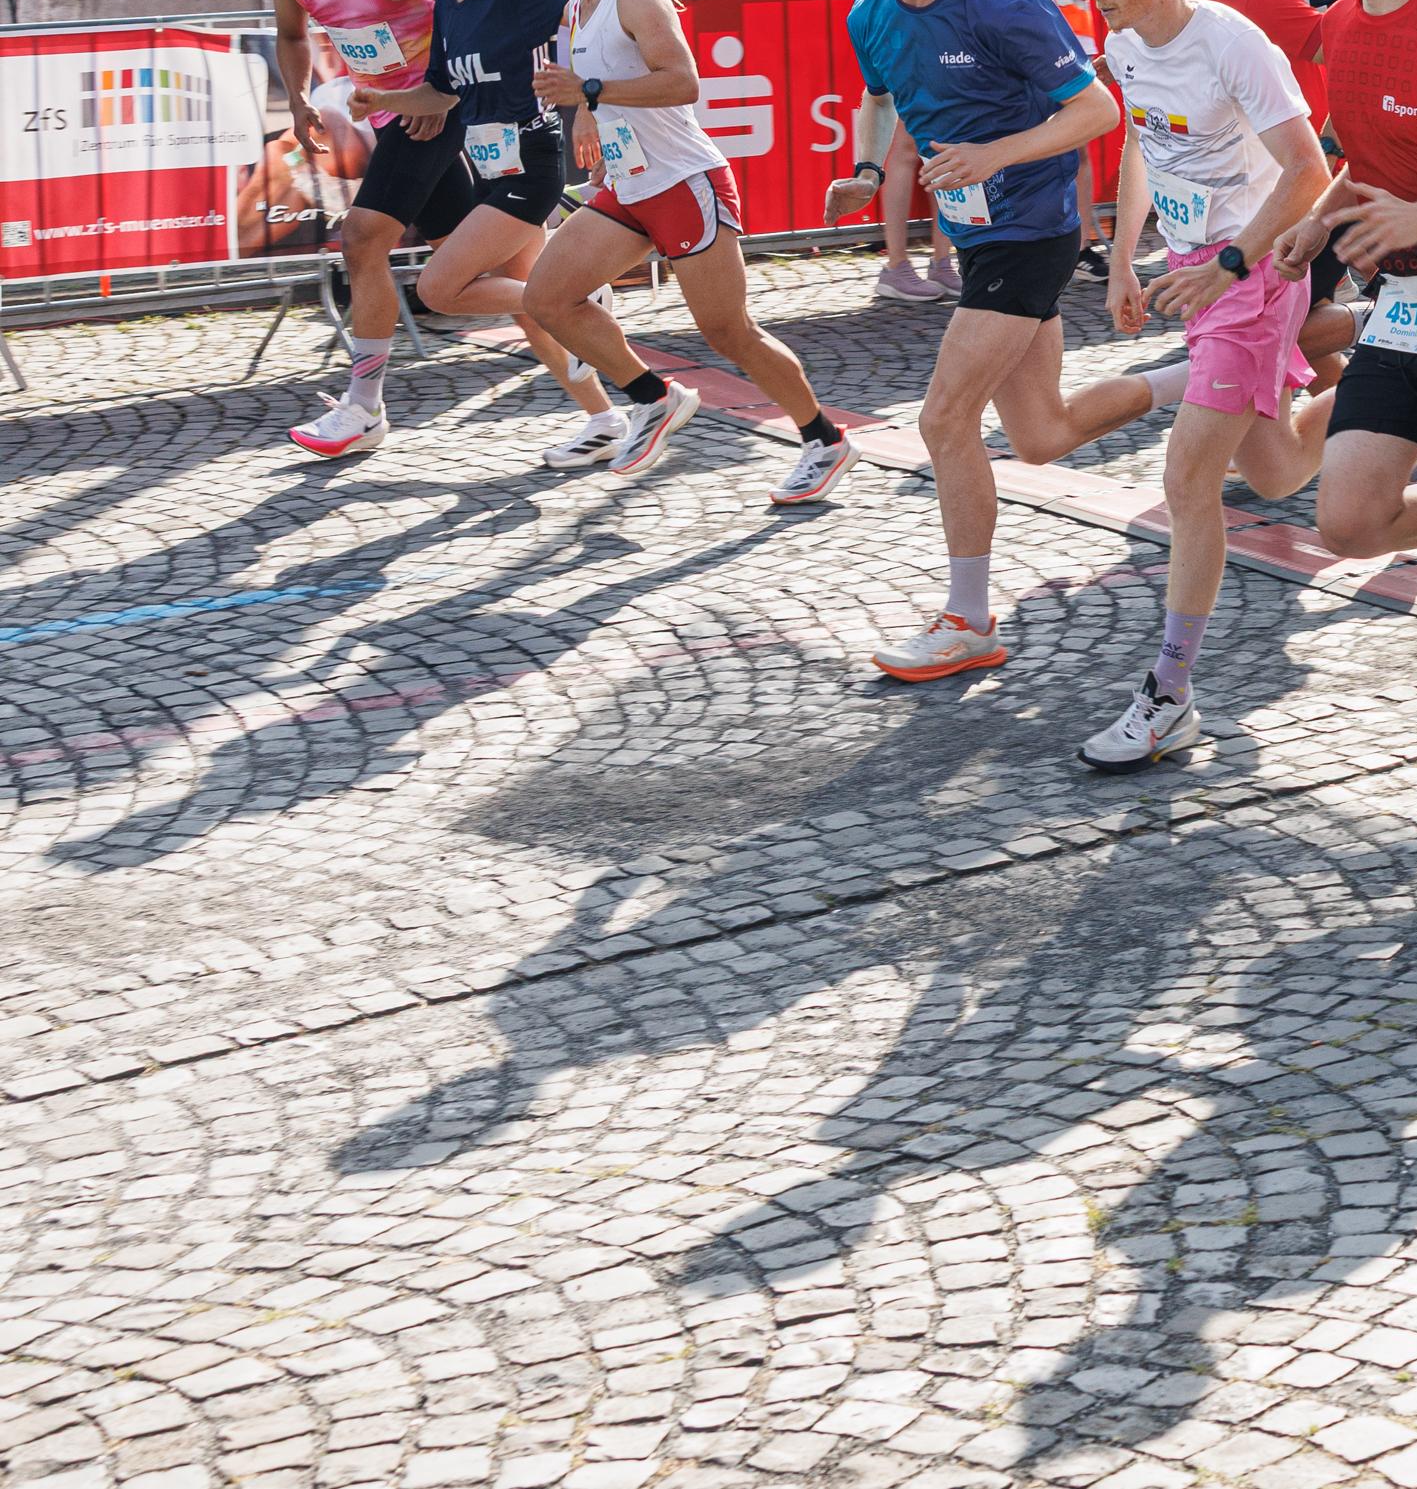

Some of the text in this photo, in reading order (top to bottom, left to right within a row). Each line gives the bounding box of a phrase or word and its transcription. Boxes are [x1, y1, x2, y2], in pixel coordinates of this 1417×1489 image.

[341, 43, 378, 60] 4839
[80, 138, 138, 153] Zentrum
[167, 131, 248, 148] Sportmedizin
[470, 142, 501, 161] 4305
[1153, 190, 1189, 225] 4433
[33, 209, 226, 240] www.zfs-muenster.de
